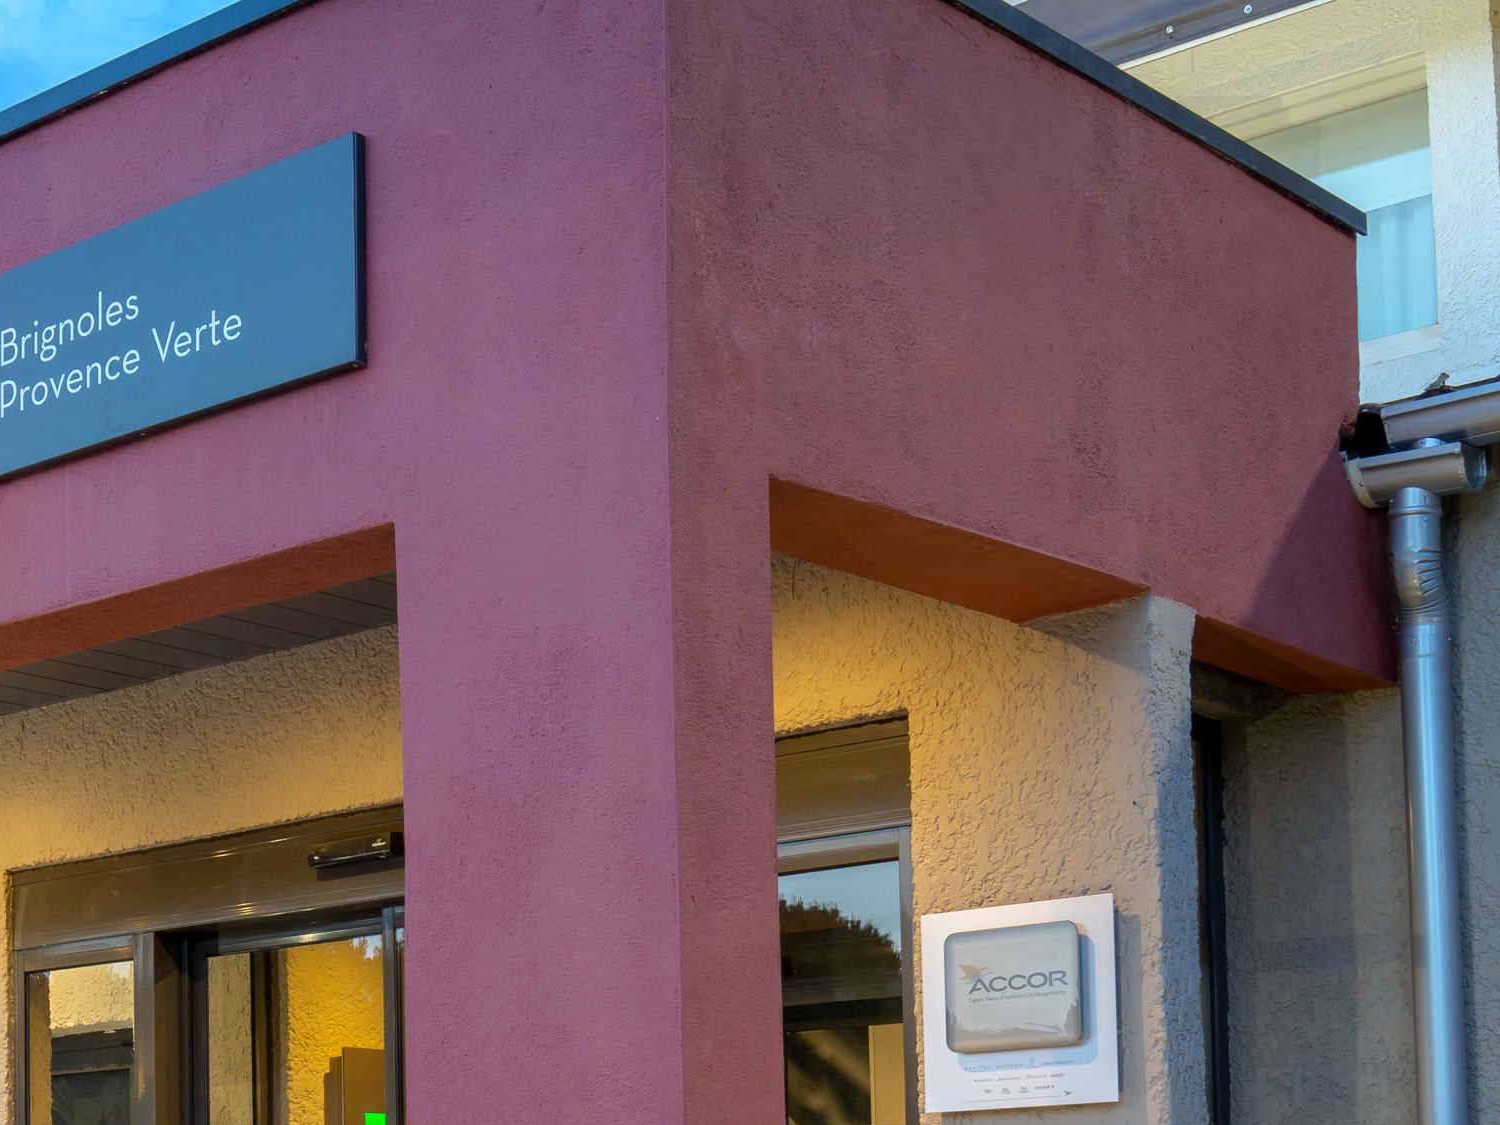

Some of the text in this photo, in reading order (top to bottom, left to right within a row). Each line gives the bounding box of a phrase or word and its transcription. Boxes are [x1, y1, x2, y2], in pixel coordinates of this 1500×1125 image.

[0, 291, 139, 366] Brignoles
[0, 310, 242, 418] Provence Verte
[968, 970, 1069, 994] ACCOR
